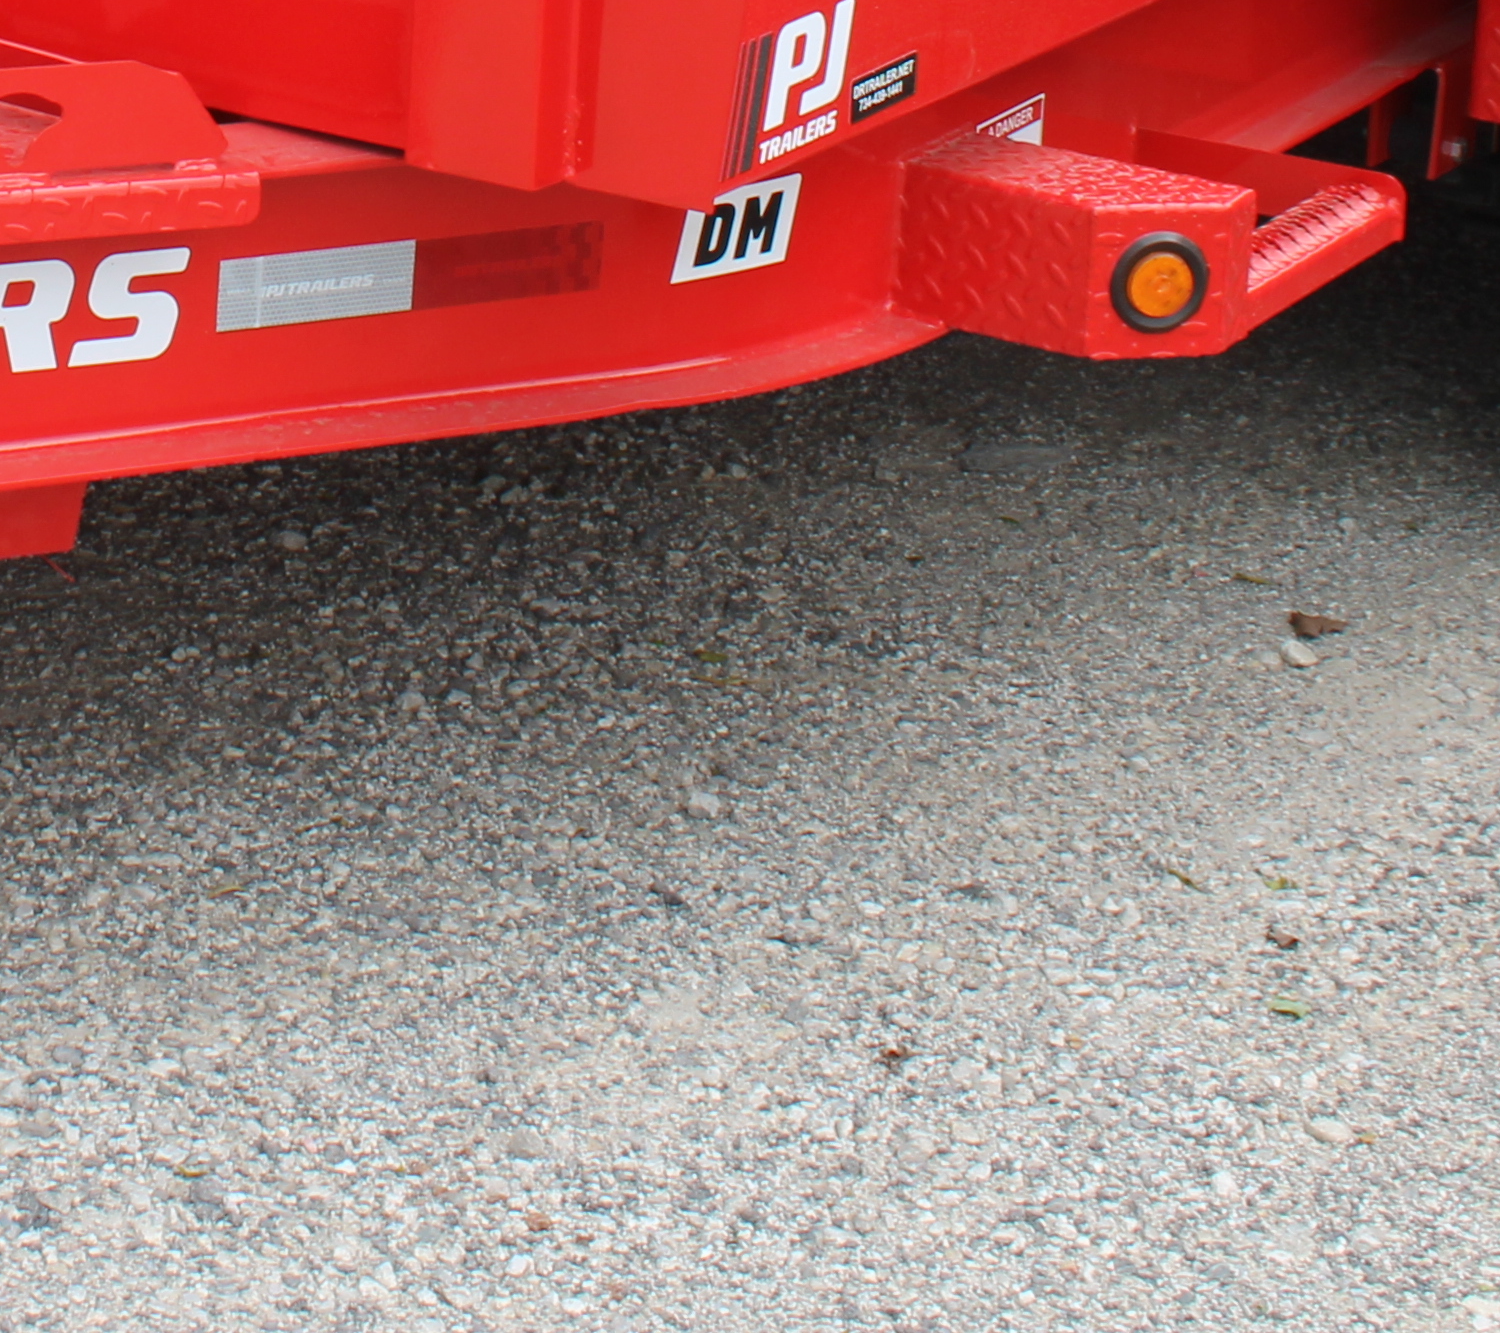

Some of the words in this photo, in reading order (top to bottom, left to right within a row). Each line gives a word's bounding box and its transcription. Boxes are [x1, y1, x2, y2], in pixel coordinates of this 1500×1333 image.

[853, 59, 915, 101] DRTRAILER.NET
[759, 110, 838, 164] TRAILERS
[995, 106, 1034, 138] DANGER
[693, 190, 784, 268] DM
